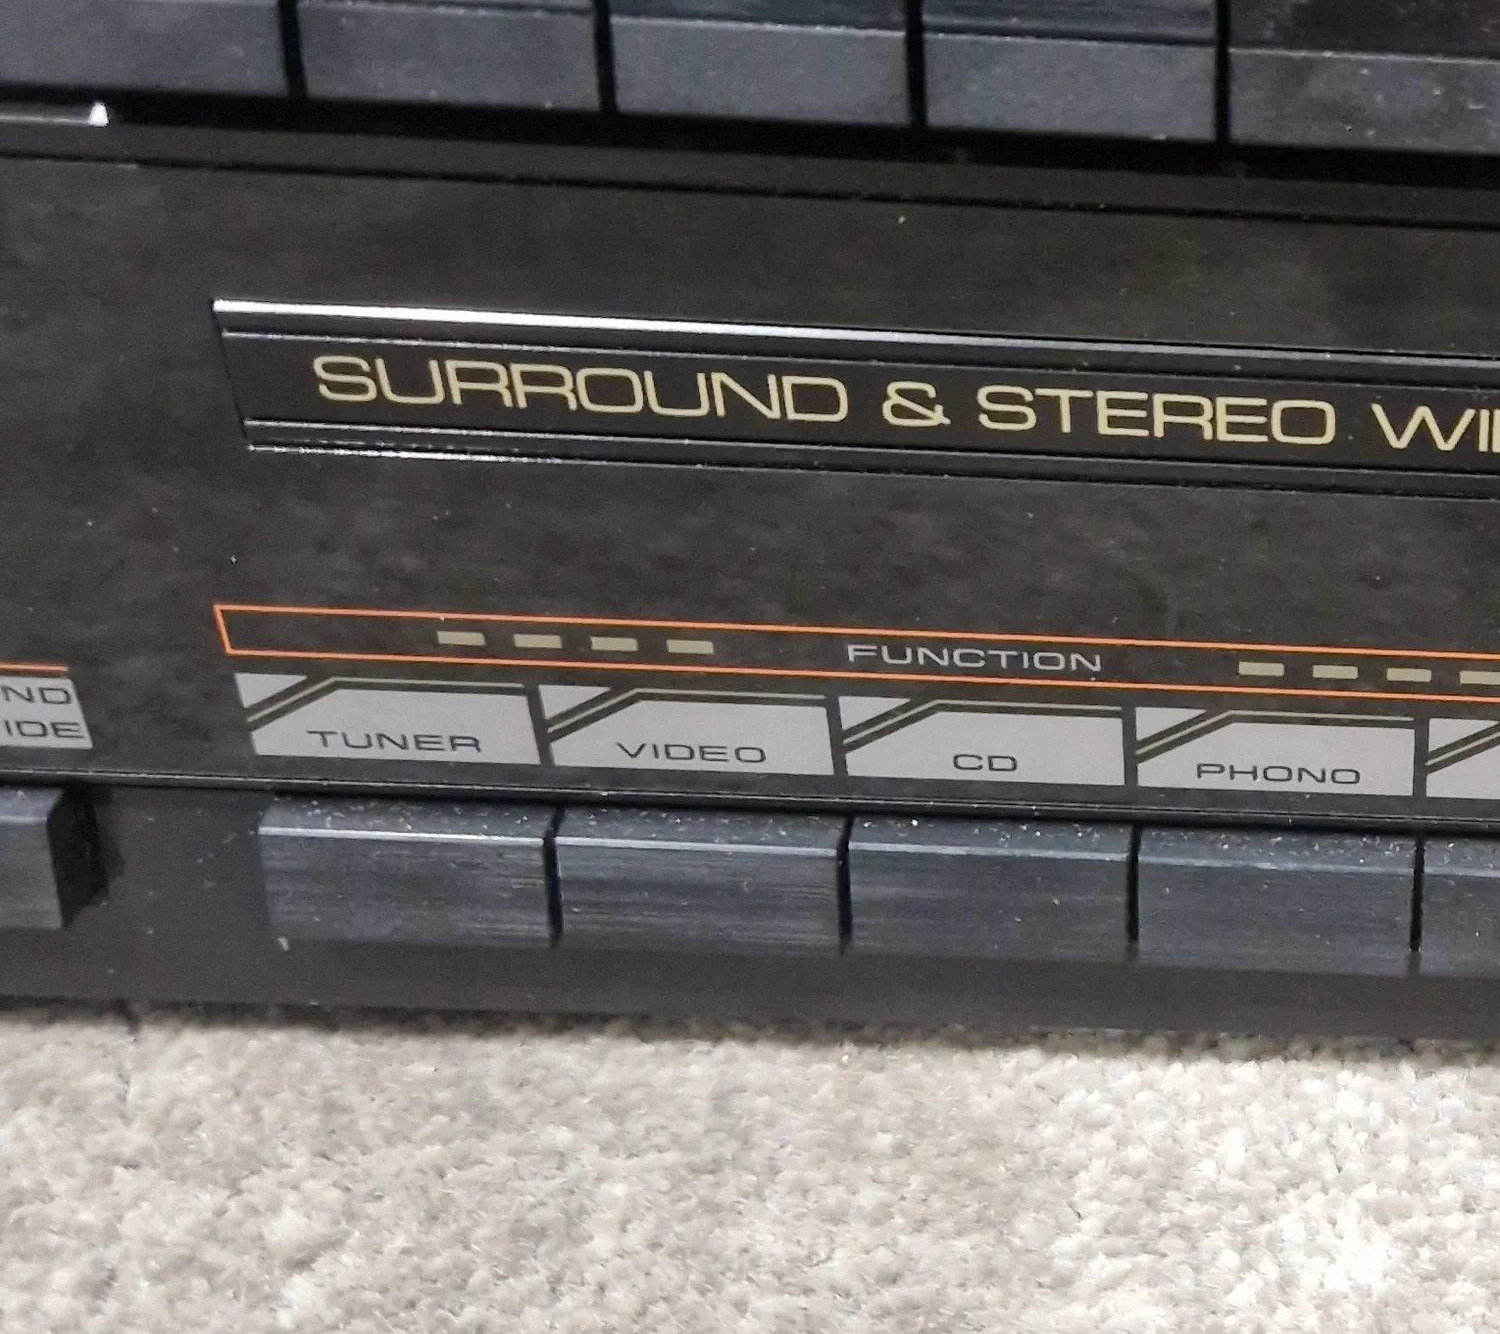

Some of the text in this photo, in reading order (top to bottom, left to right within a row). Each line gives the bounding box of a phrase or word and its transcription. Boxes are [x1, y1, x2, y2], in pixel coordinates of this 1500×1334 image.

[311, 355, 848, 423] SURROUND
[882, 381, 951, 427] &
[977, 385, 1336, 445] STEREO
[847, 643, 1102, 673] FUNCTION
[306, 729, 483, 754] TUNER
[615, 740, 767, 766] VIDEO
[951, 753, 1019, 773] CD
[1194, 762, 1362, 787] PHONO
